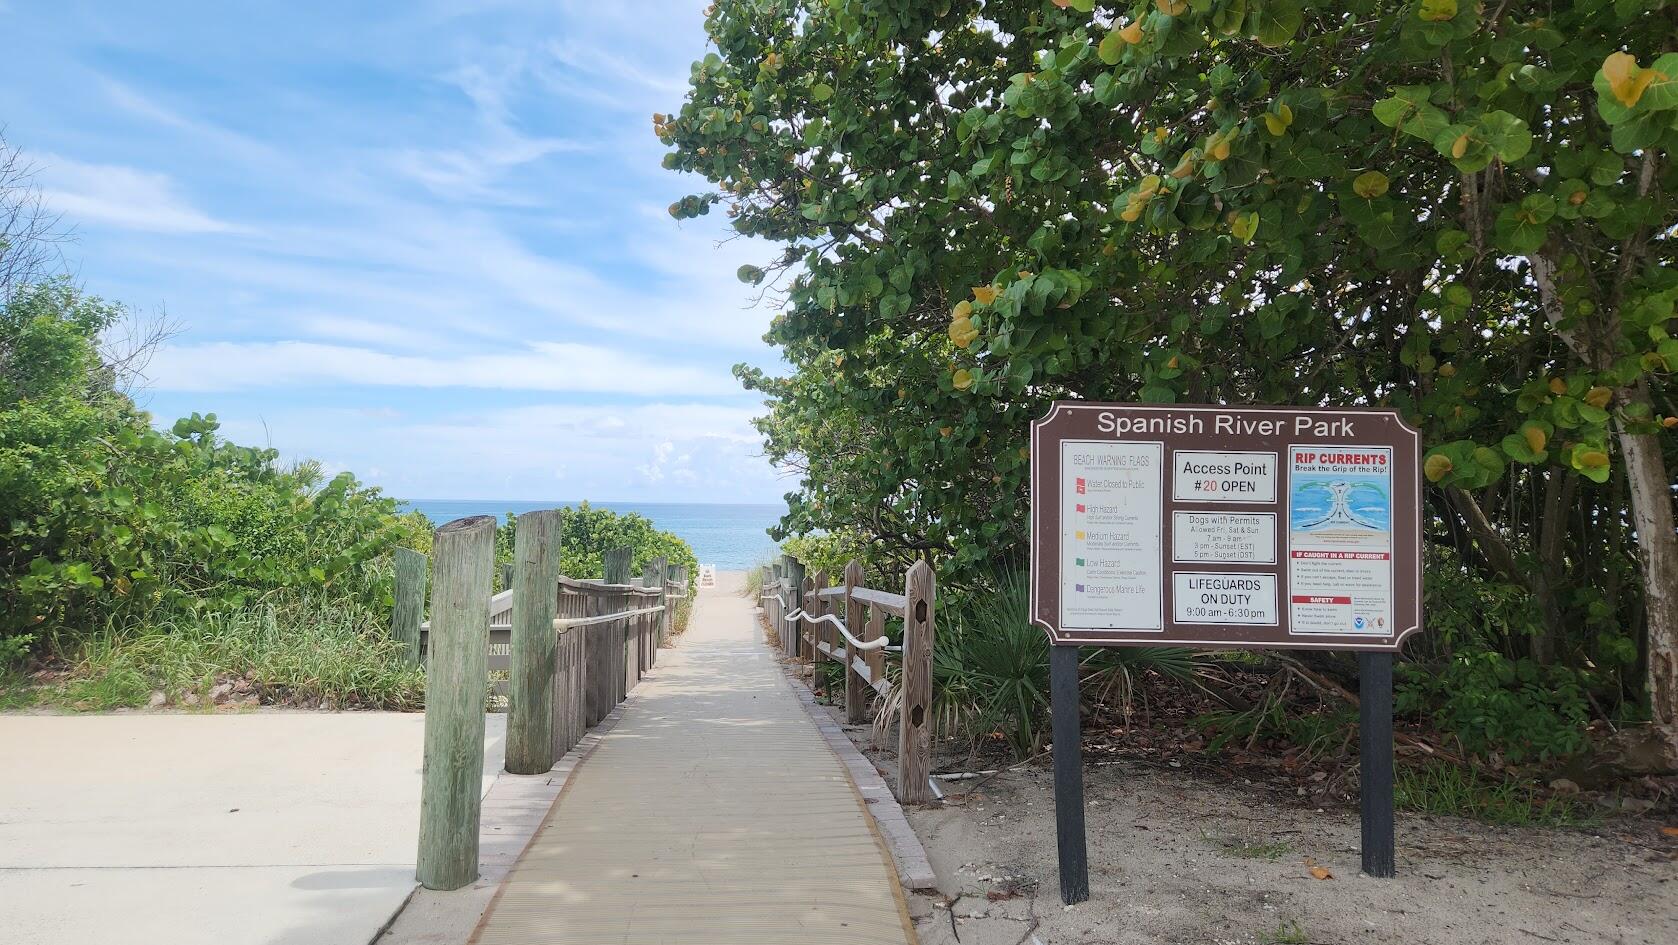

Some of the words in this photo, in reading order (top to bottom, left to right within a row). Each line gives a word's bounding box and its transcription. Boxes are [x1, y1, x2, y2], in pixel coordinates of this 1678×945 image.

[1098, 412, 1203, 437] Spanish
[1215, 416, 1285, 435] River
[1295, 417, 1355, 437] Park
[1074, 455, 1094, 465] BEACH
[1097, 455, 1126, 465] WARNING
[1130, 456, 1149, 466] FLAGS
[1296, 453, 1315, 463] RIP
[1320, 454, 1386, 465] CURRENTS
[1184, 462, 1230, 474] Access
[1235, 462, 1267, 475] Point
[1087, 480, 1102, 488] Water
[1104, 480, 1121, 488] Closed
[1123, 480, 1127, 488] to
[1222, 481, 1255, 492] OPEN
[1100, 505, 1117, 513] Hazard
[1189, 516, 1208, 525] Dogs
[1211, 516, 1227, 524] with
[1230, 516, 1260, 525] Permits
[1110, 532, 1129, 541] Hazard
[1238, 543, 1255, 551] (EST)
[1214, 551, 1236, 559] Sunset
[1100, 559, 1120, 567] Hazard
[1136, 585, 1145, 593] Life
[1189, 578, 1261, 590] LIFEGUARDS
[1201, 594, 1217, 604] ON
[1221, 594, 1251, 605] DUTY
[1187, 607, 1206, 617] 9:00
[1209, 609, 1221, 617] am
[1229, 608, 1249, 617] 6:30
[1251, 610, 1265, 619] pm
